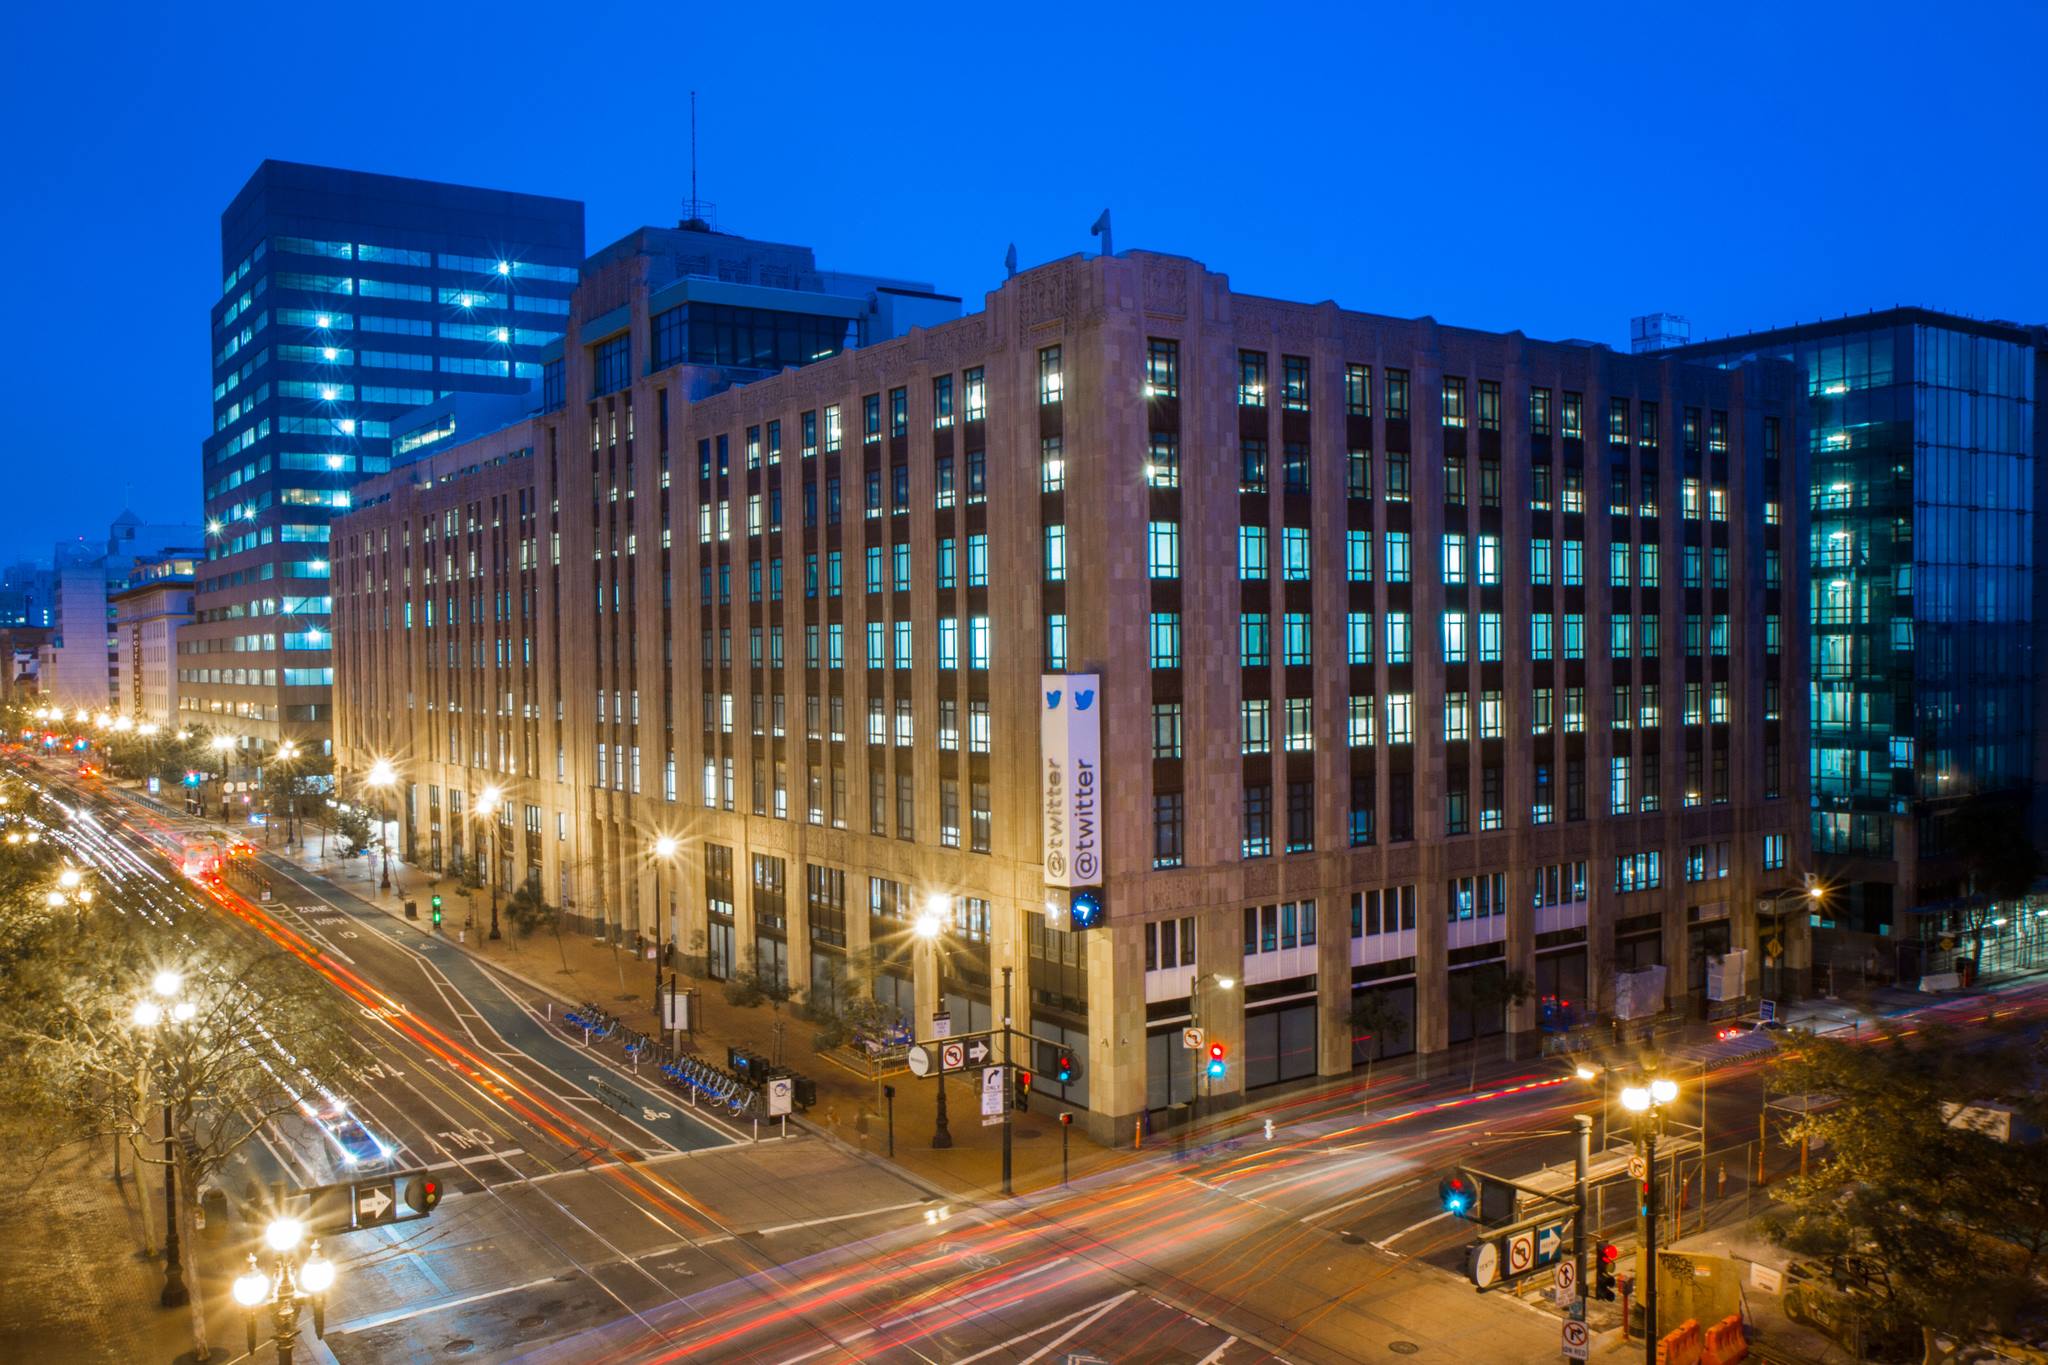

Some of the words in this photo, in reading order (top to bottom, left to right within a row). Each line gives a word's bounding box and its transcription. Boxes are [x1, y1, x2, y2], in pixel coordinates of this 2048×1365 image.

[1046, 758, 1067, 878] @twitter
[1074, 758, 1098, 880] @twitter
[295, 905, 333, 913] ZONE
[430, 1128, 495, 1154] ONLY
